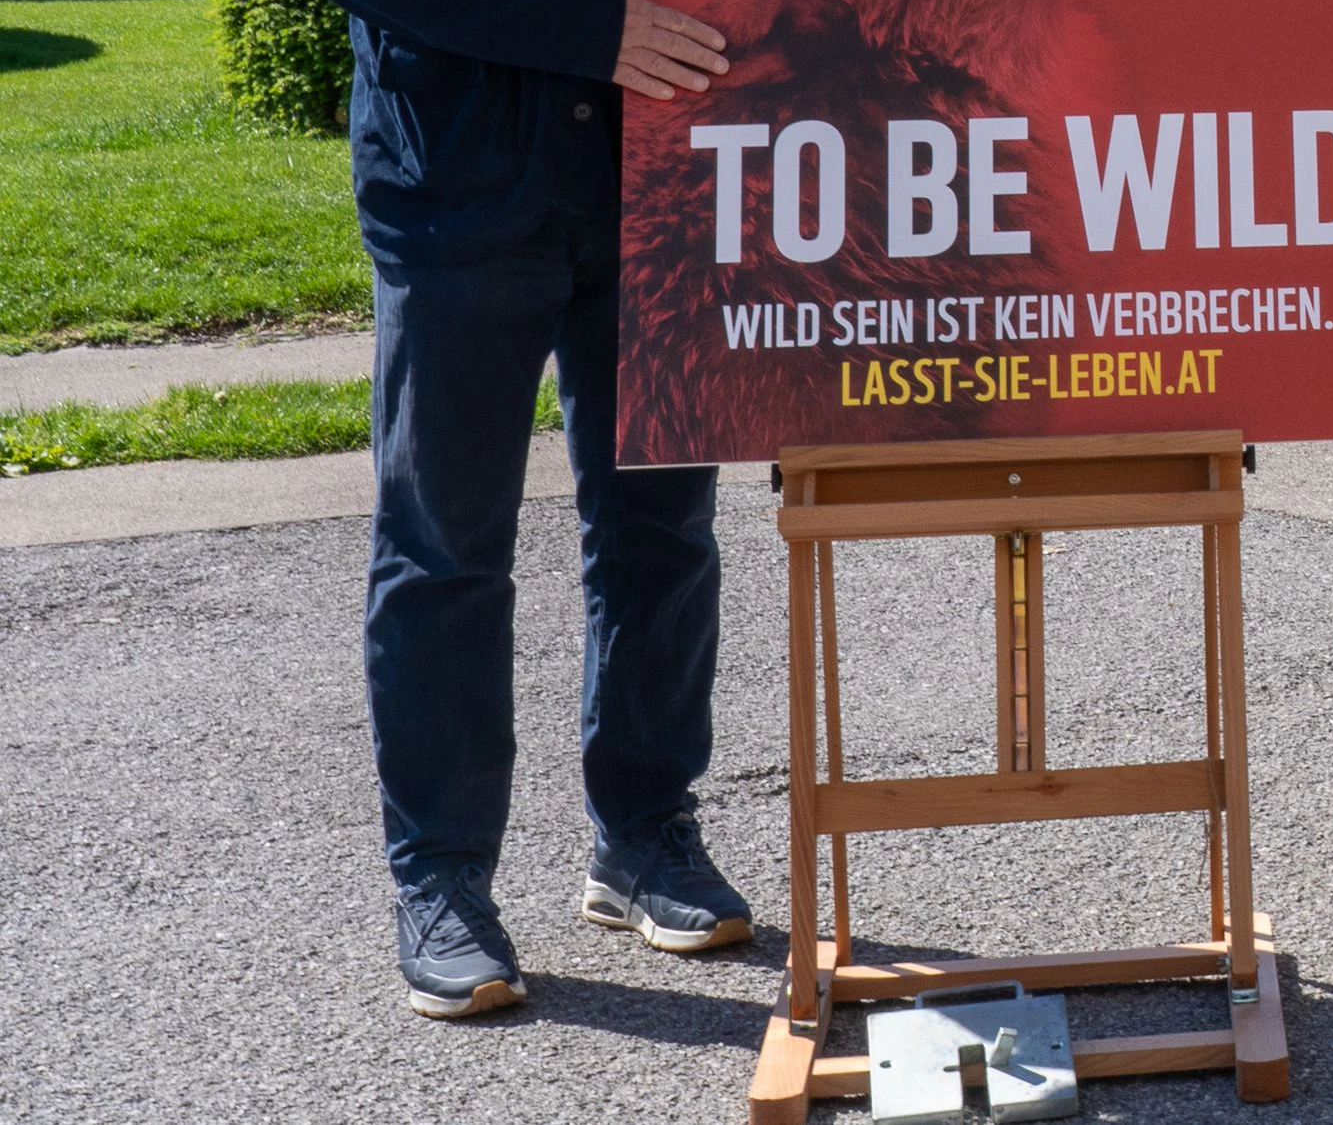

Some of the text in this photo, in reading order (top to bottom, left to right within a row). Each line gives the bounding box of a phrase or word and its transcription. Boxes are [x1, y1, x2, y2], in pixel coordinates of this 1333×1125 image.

[690, 120, 845, 263] TO
[888, 117, 1030, 258] BE
[723, 287, 1333, 350] WILD SEIN IST KEIN VERBRECHEN.
[842, 349, 1222, 406] LASST-SIE-LEBEN.AT
